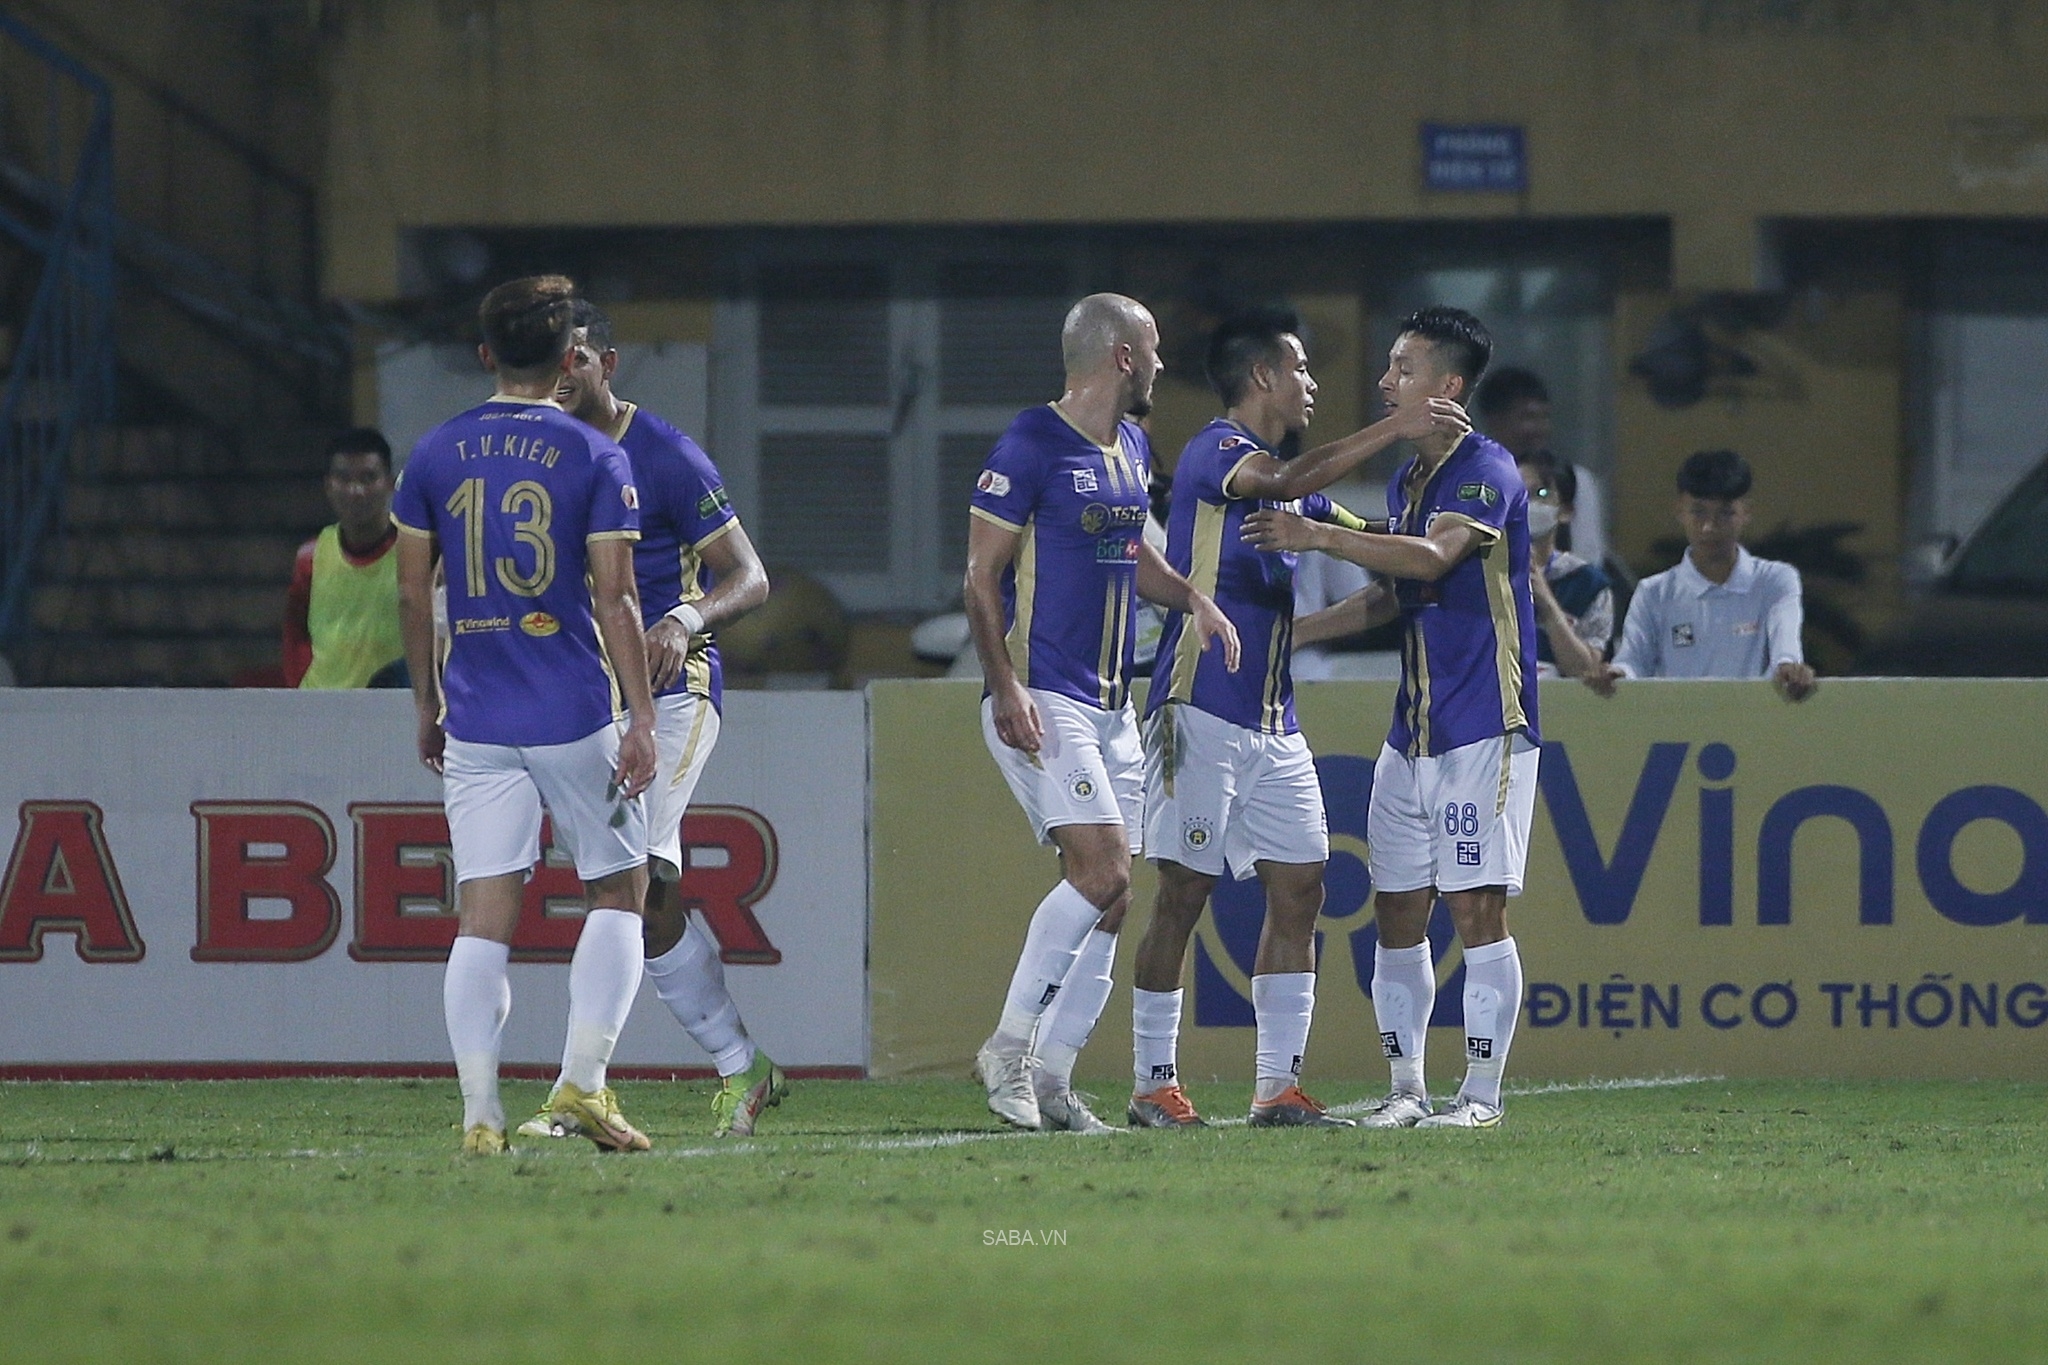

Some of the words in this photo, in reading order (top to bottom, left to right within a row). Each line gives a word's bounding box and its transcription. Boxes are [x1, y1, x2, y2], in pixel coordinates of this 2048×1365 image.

[446, 478, 556, 597] 13
[1444, 801, 1479, 837] 88
[1524, 973, 1681, 1040] ĐIỆN
[1700, 979, 1798, 1030] CƠ
